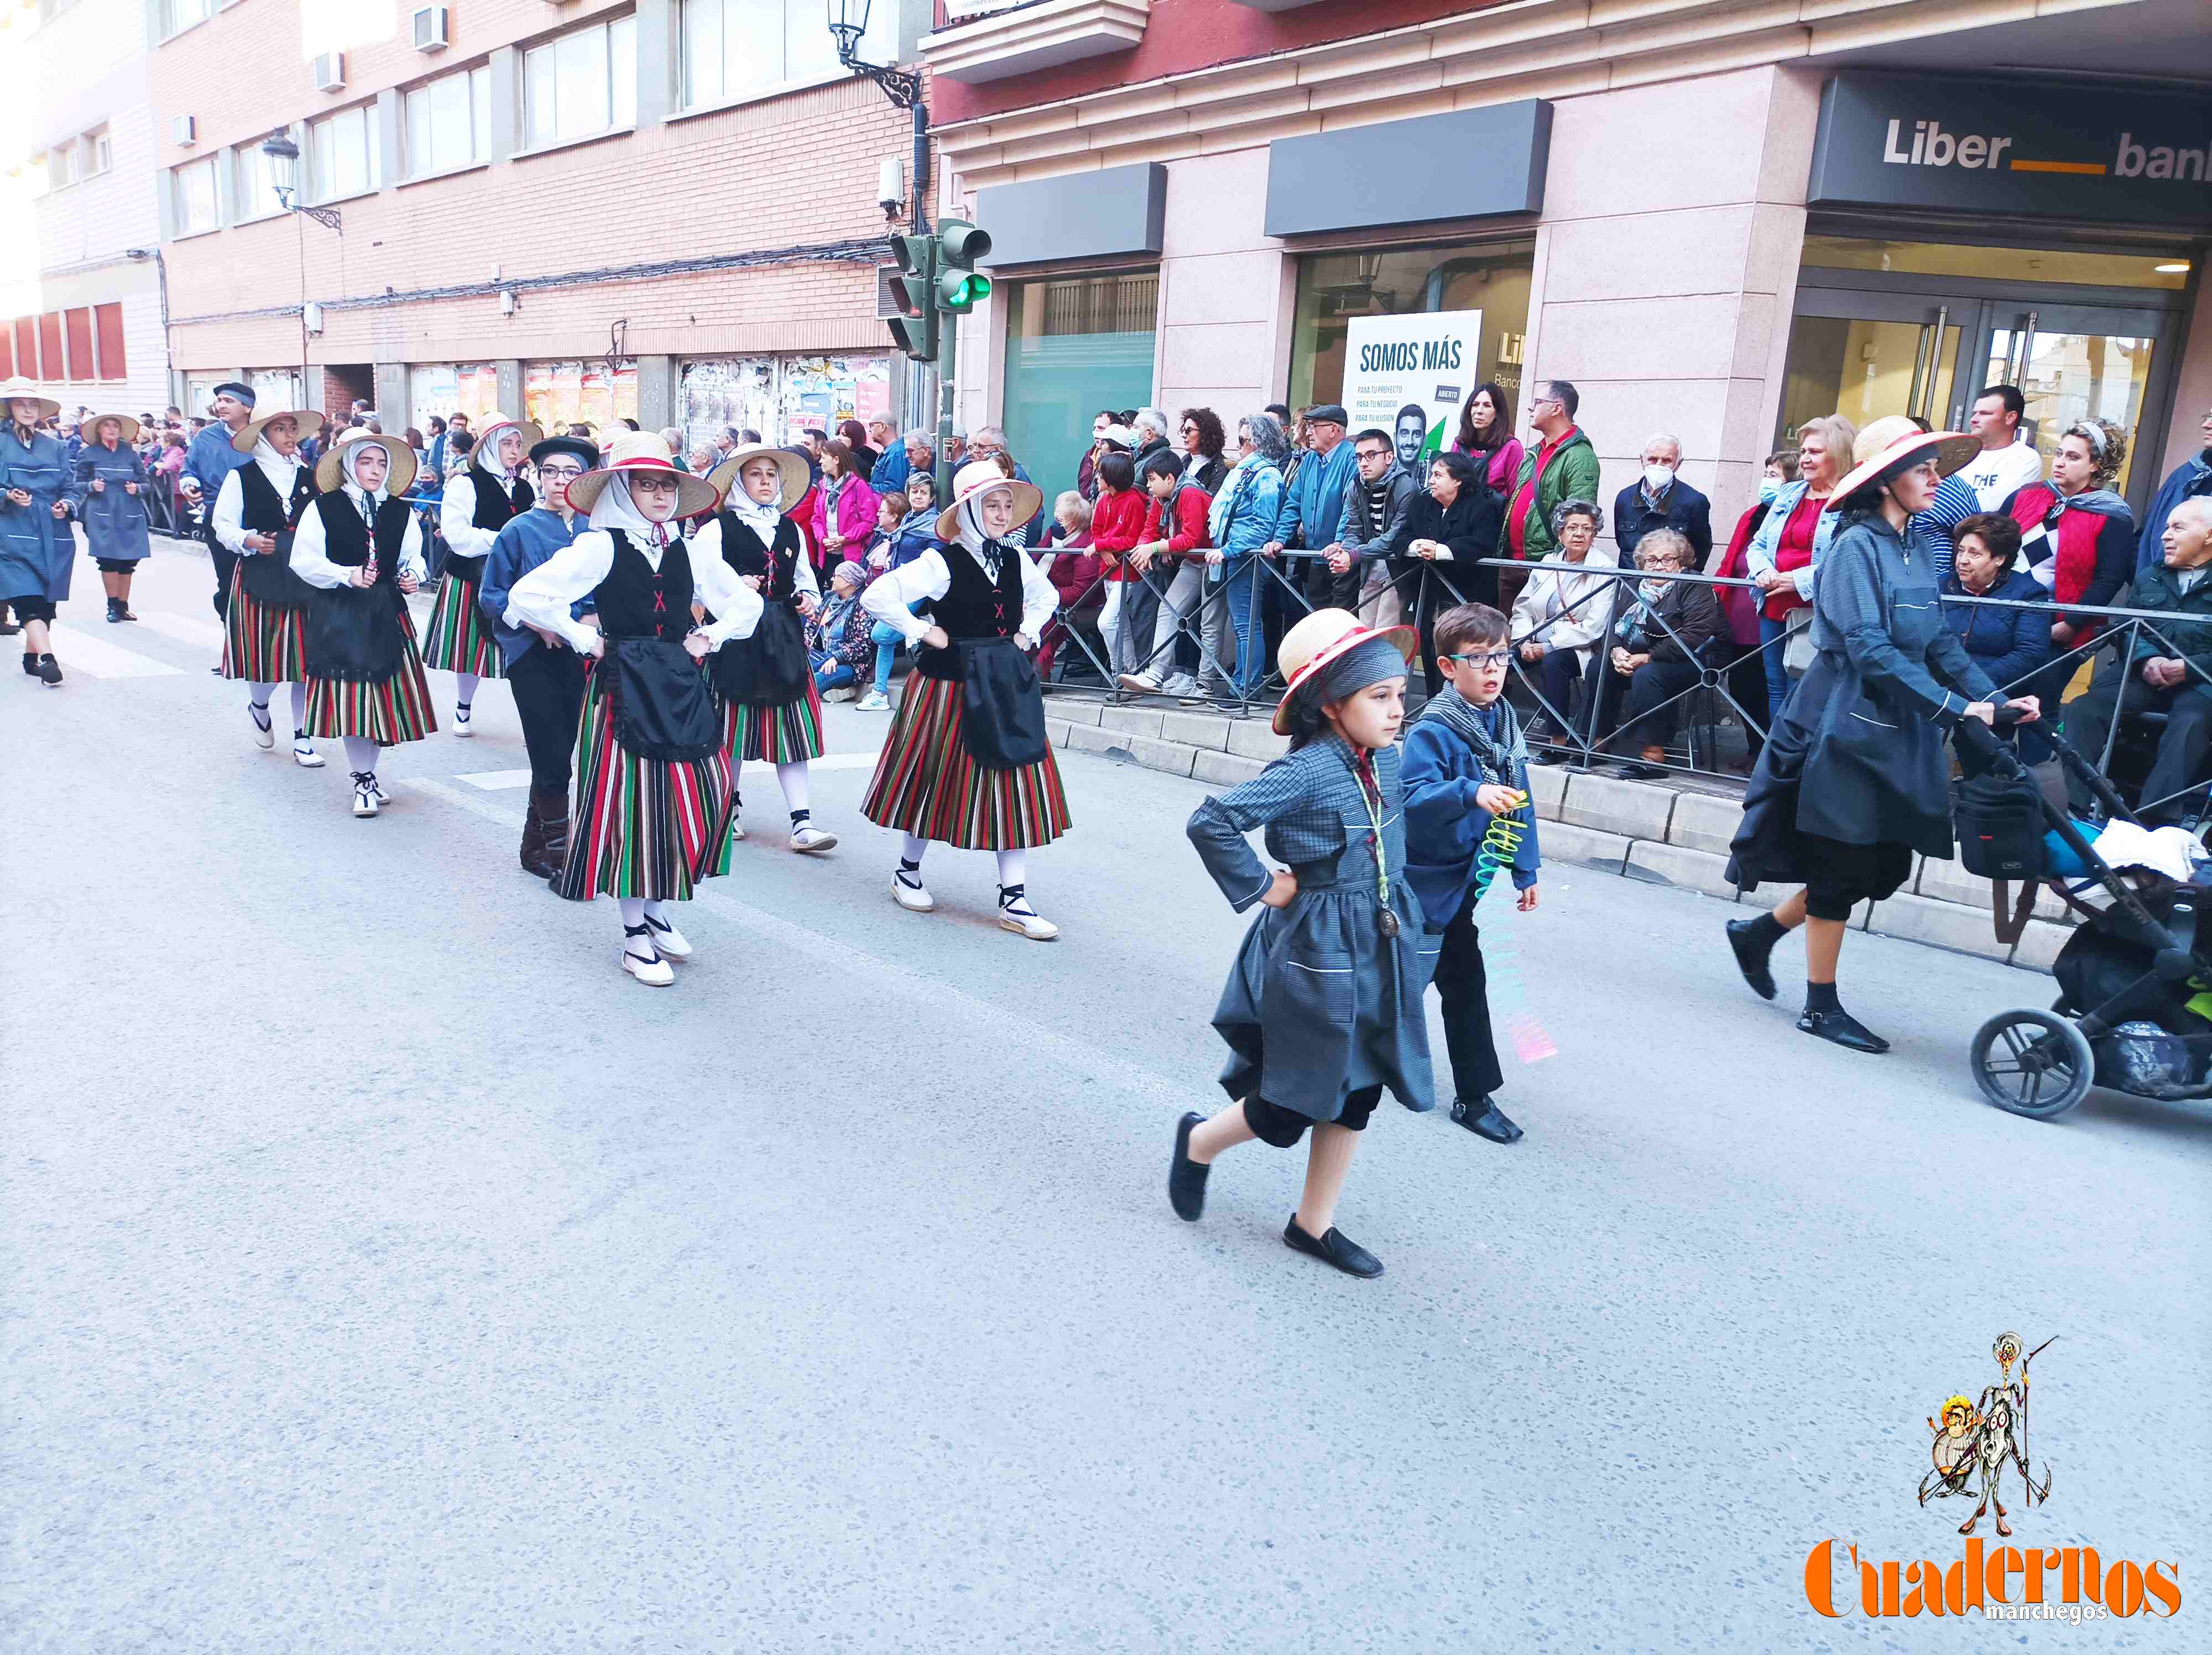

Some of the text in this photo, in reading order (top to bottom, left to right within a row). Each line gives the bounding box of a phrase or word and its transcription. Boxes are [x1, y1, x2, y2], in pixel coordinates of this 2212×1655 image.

[1883, 119, 2212, 182] Liber ban
[1360, 334, 1462, 372] SOMOS MÁS
[1378, 385, 1402, 393] PROYECTO
[1438, 389, 1458, 399] ABIERTO
[1375, 413, 1394, 421] ILUSIÓN
[1973, 474, 1999, 486] THE
